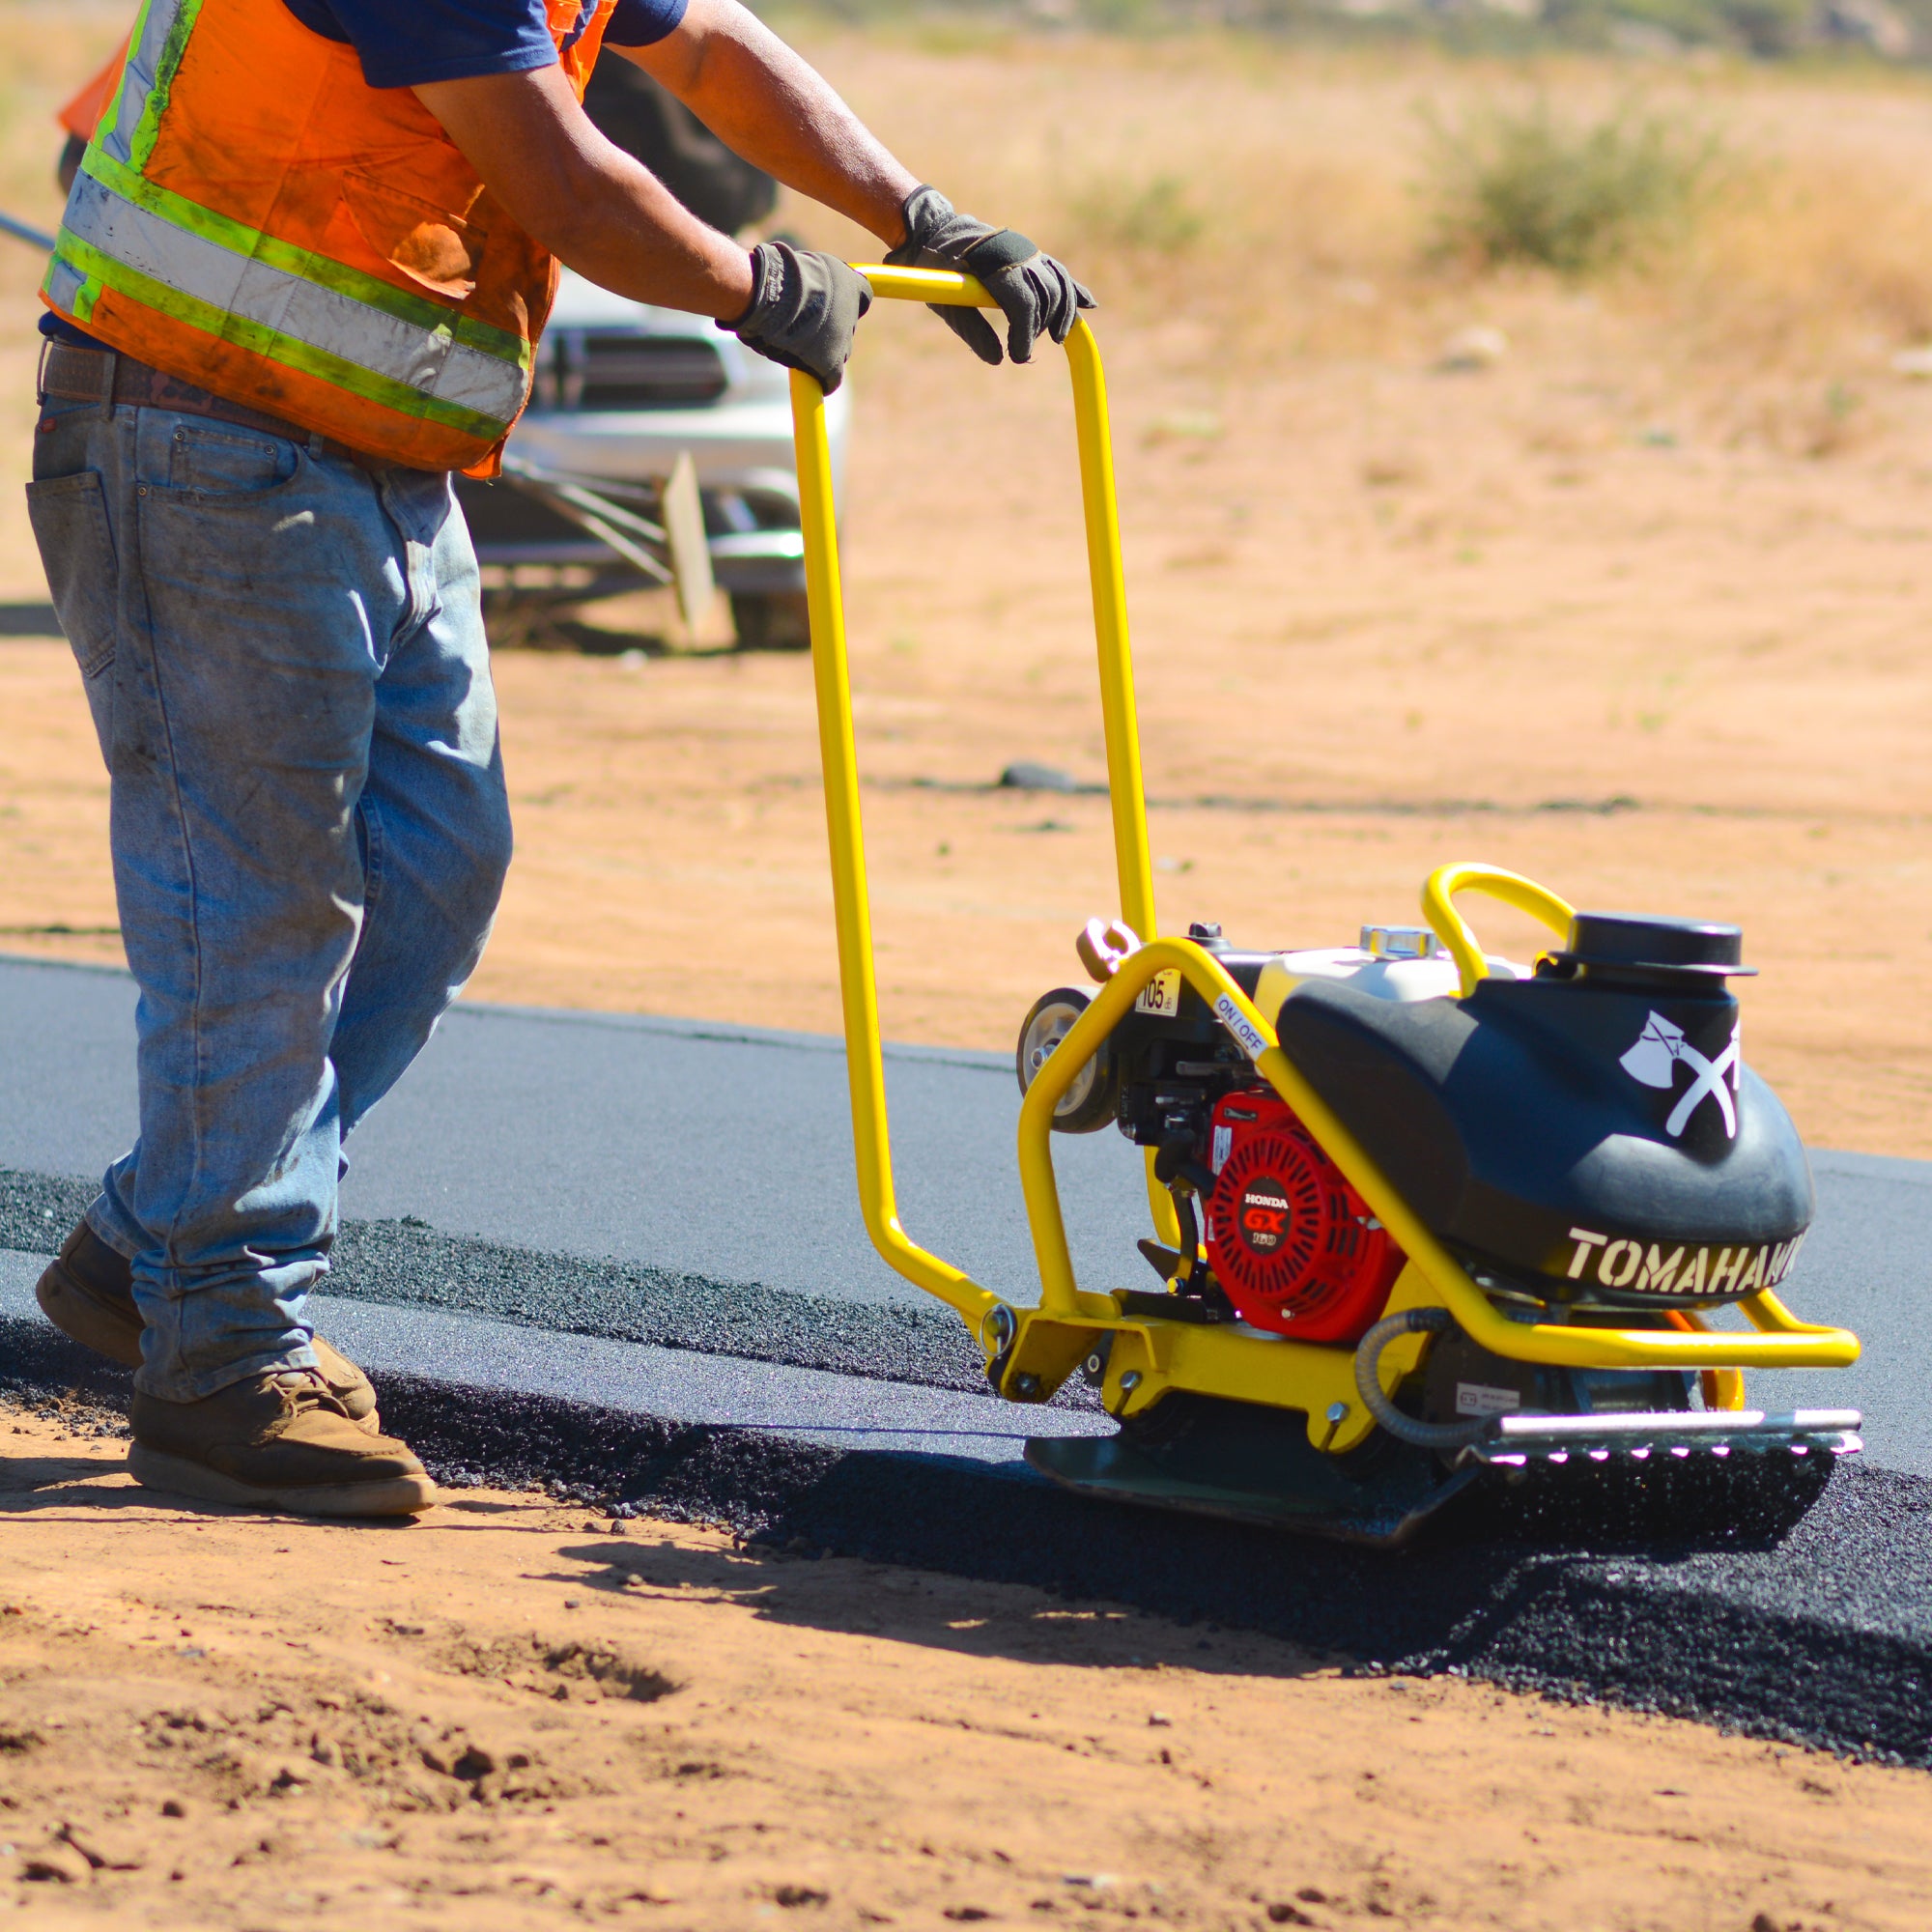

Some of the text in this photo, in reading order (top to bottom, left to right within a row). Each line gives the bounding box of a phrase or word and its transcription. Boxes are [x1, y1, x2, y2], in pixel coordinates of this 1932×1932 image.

[1143, 979, 1164, 1009] 105
[1218, 999, 1237, 1021] ON
[1238, 1024, 1263, 1050] OFF
[1245, 1194, 1289, 1208] HONDA
[1243, 1208, 1286, 1234] GX
